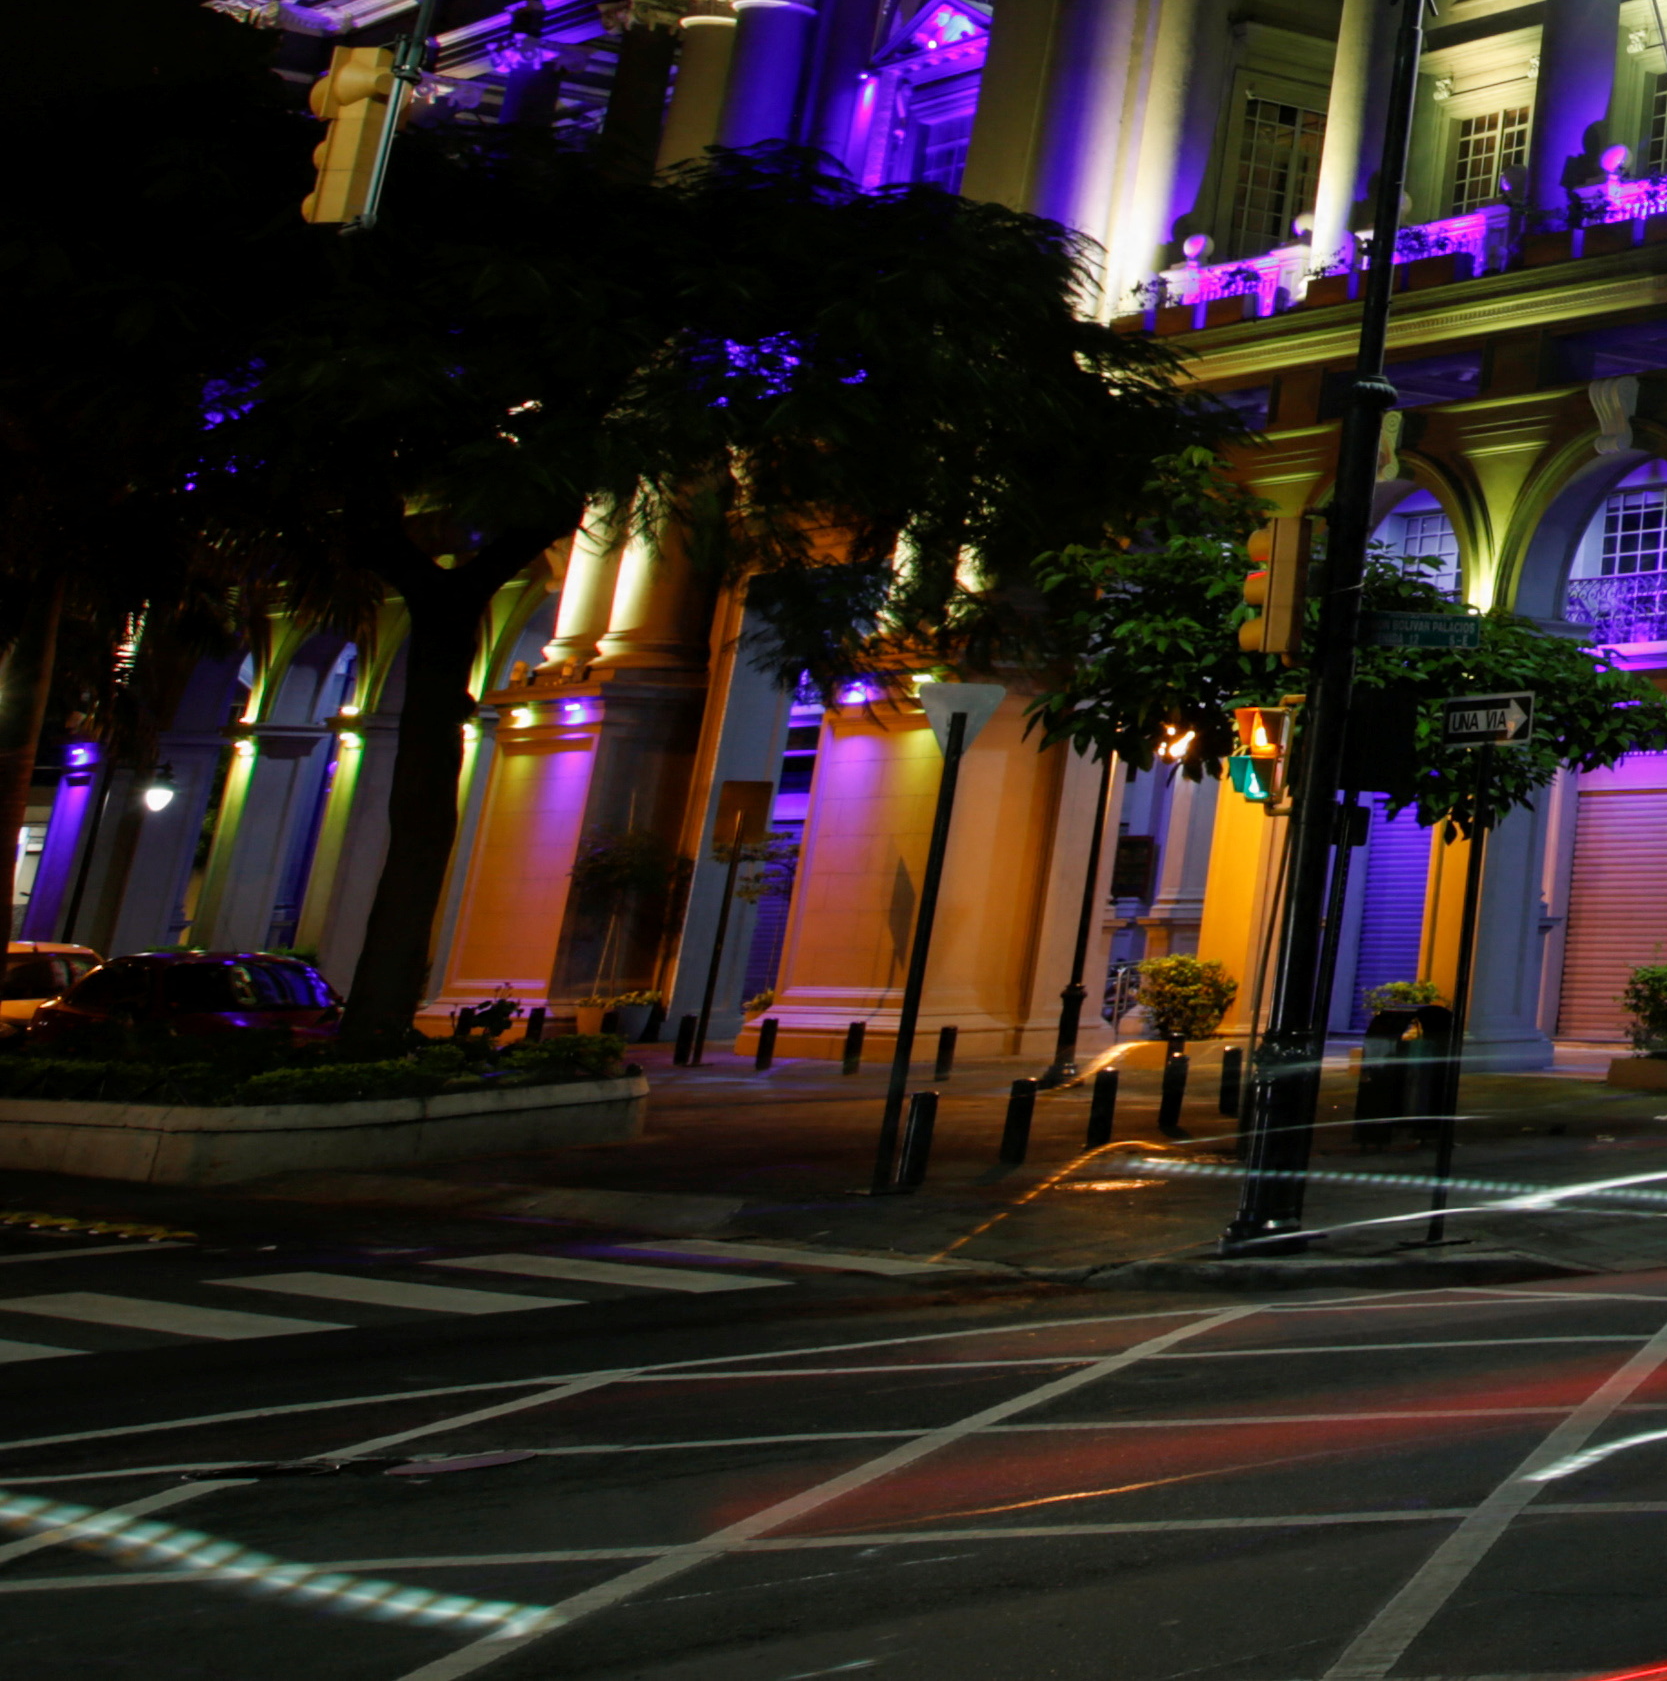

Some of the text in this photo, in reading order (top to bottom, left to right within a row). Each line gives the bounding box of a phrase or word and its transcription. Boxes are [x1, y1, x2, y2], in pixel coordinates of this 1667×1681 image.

[1392, 619, 1431, 632] BOLIVAR
[1432, 621, 1476, 635] PALACIOS
[1452, 710, 1507, 731] UNA VIA
